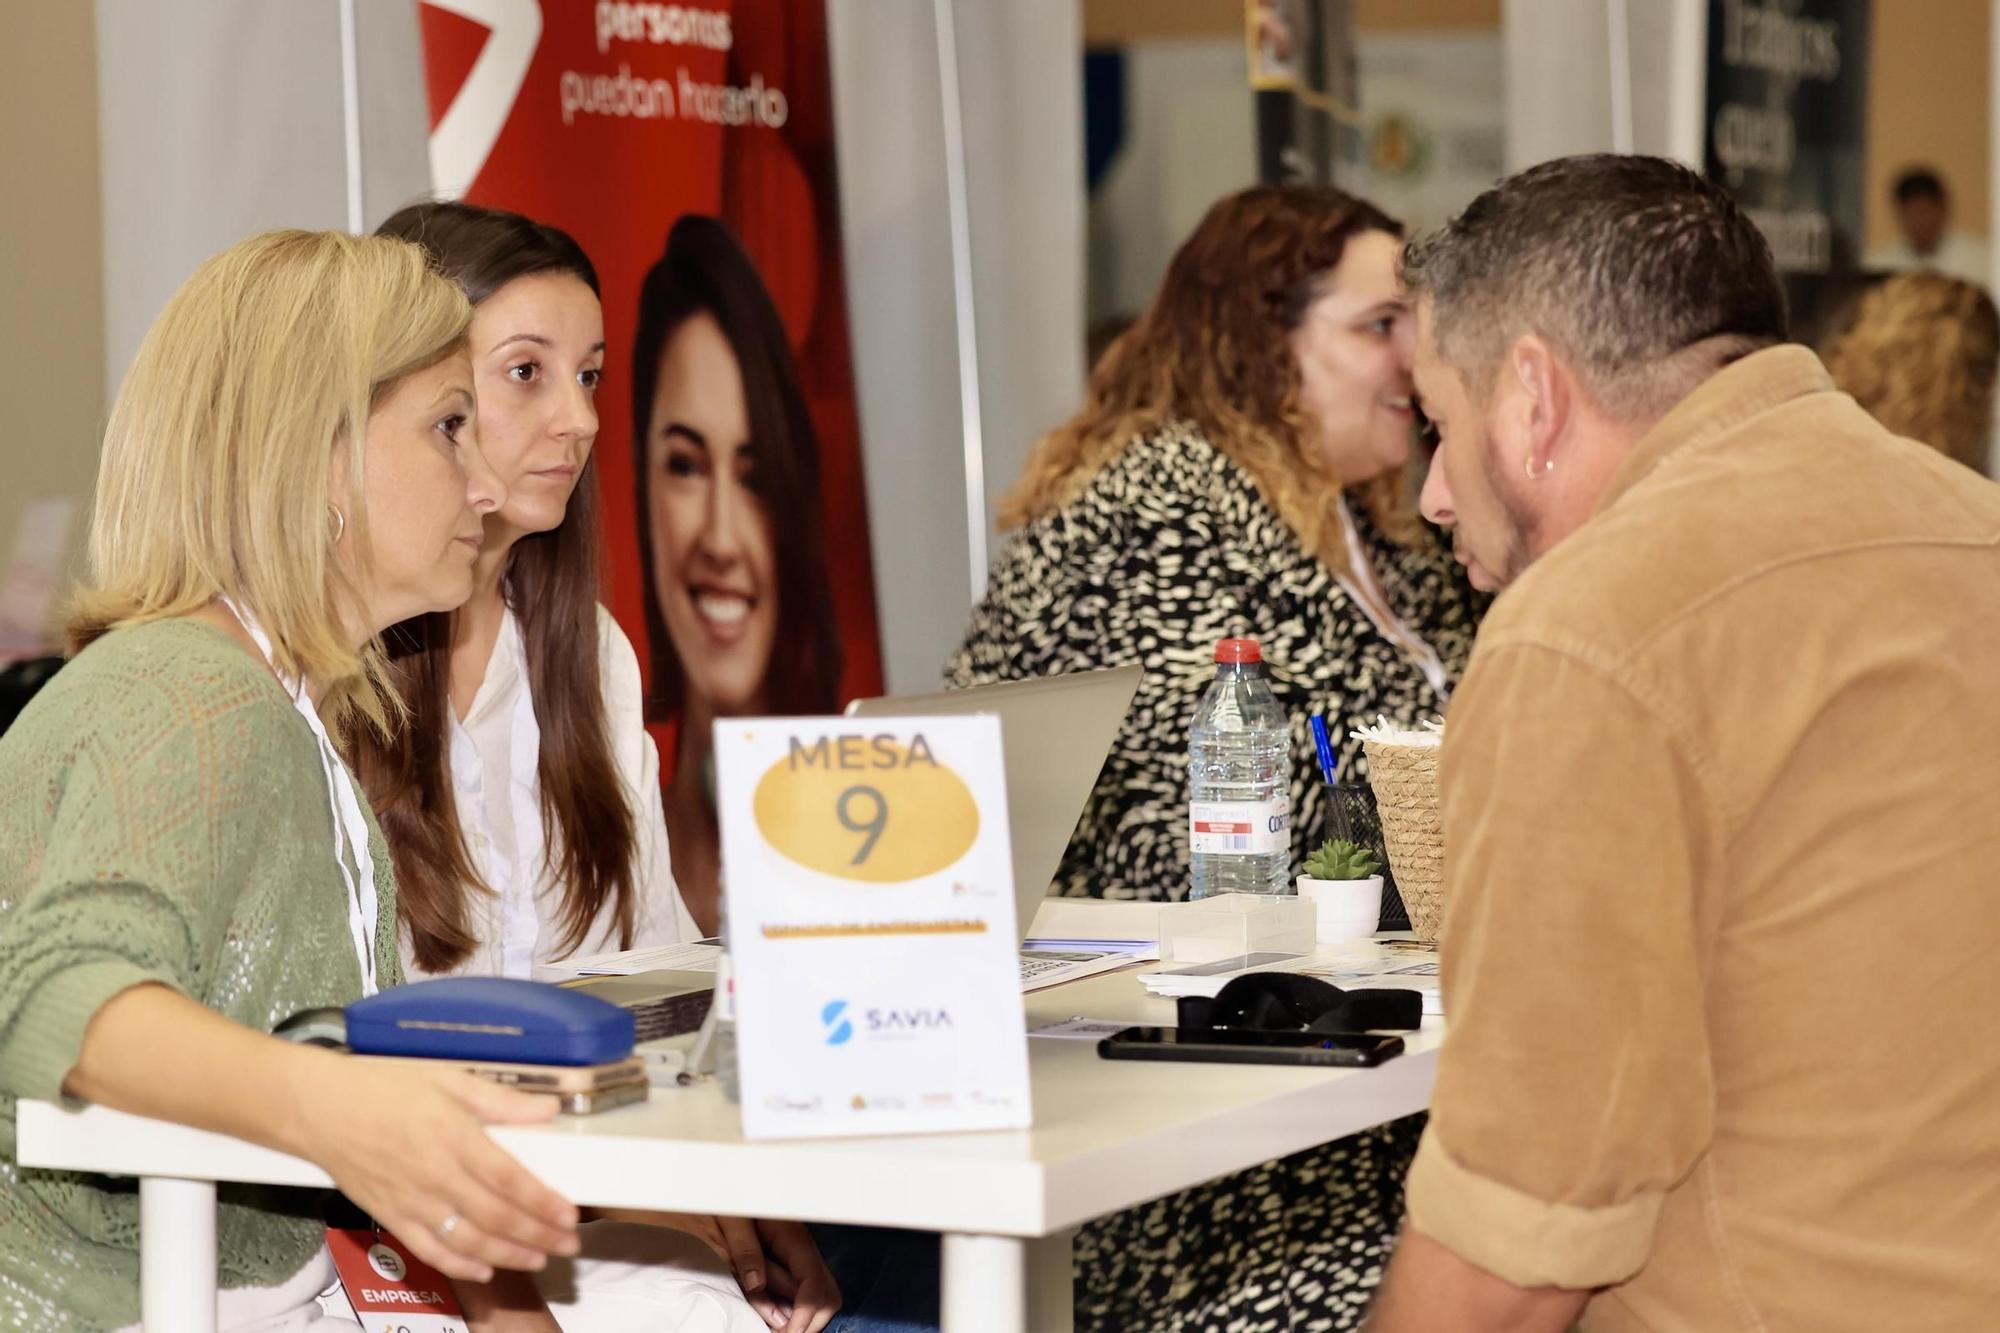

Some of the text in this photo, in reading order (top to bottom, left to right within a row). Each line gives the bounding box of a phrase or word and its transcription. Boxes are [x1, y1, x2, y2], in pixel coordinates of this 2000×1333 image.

[595, 0, 733, 53] personas
[560, 63, 788, 128] puedan hacerlo
[788, 733, 938, 770] MESA
[836, 785, 888, 866] 9
[866, 1009, 951, 1030] SAVIA
[361, 1289, 445, 1304] EMPRESA
